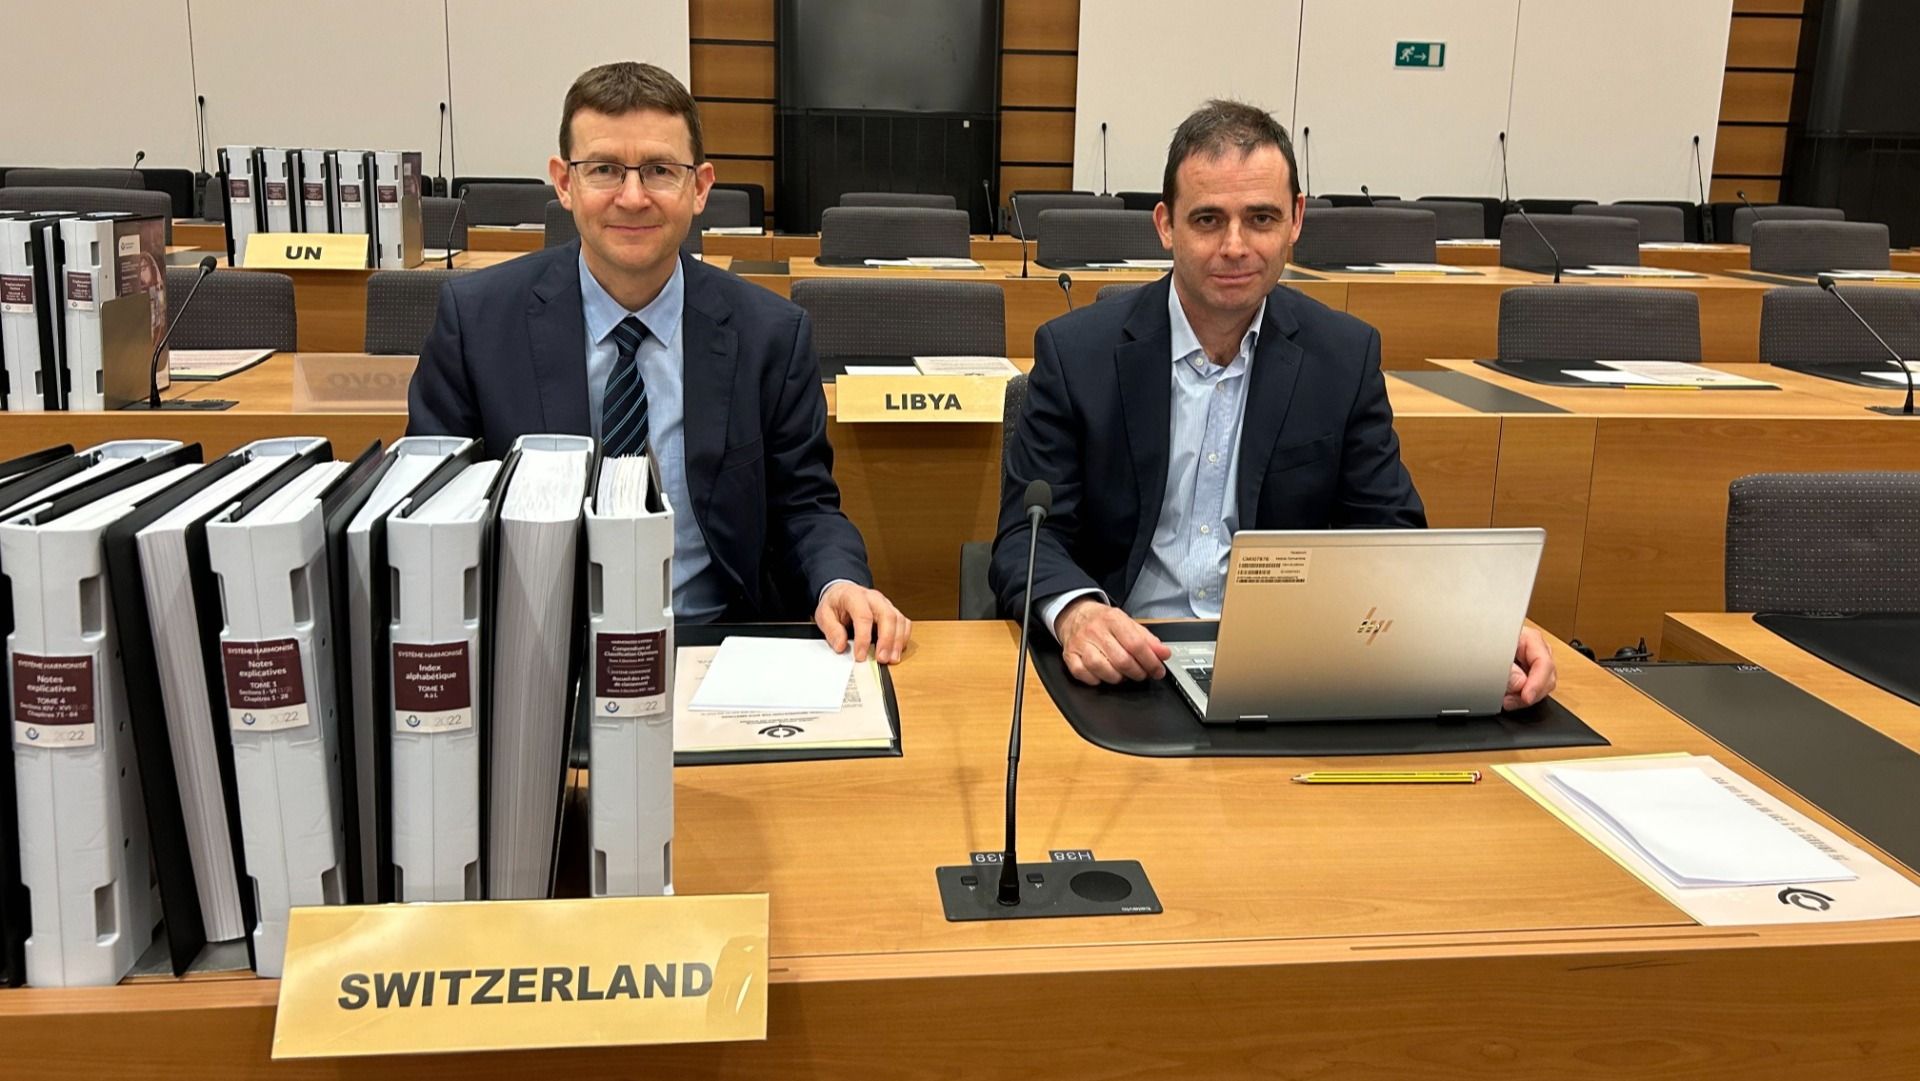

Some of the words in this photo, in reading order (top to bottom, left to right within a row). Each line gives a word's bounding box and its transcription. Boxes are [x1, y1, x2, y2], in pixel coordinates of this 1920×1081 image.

[285, 245, 322, 260] UN
[885, 393, 962, 410] LIBYA
[239, 668, 287, 678] explicatives
[405, 672, 457, 681] alphabétique
[36, 675, 64, 683] Notes
[26, 684, 77, 693] explicatives
[249, 681, 271, 689] TOME
[37, 697, 59, 705] TOME
[1053, 851, 1093, 862] H38
[337, 962, 713, 1011] SWITZERLAND
